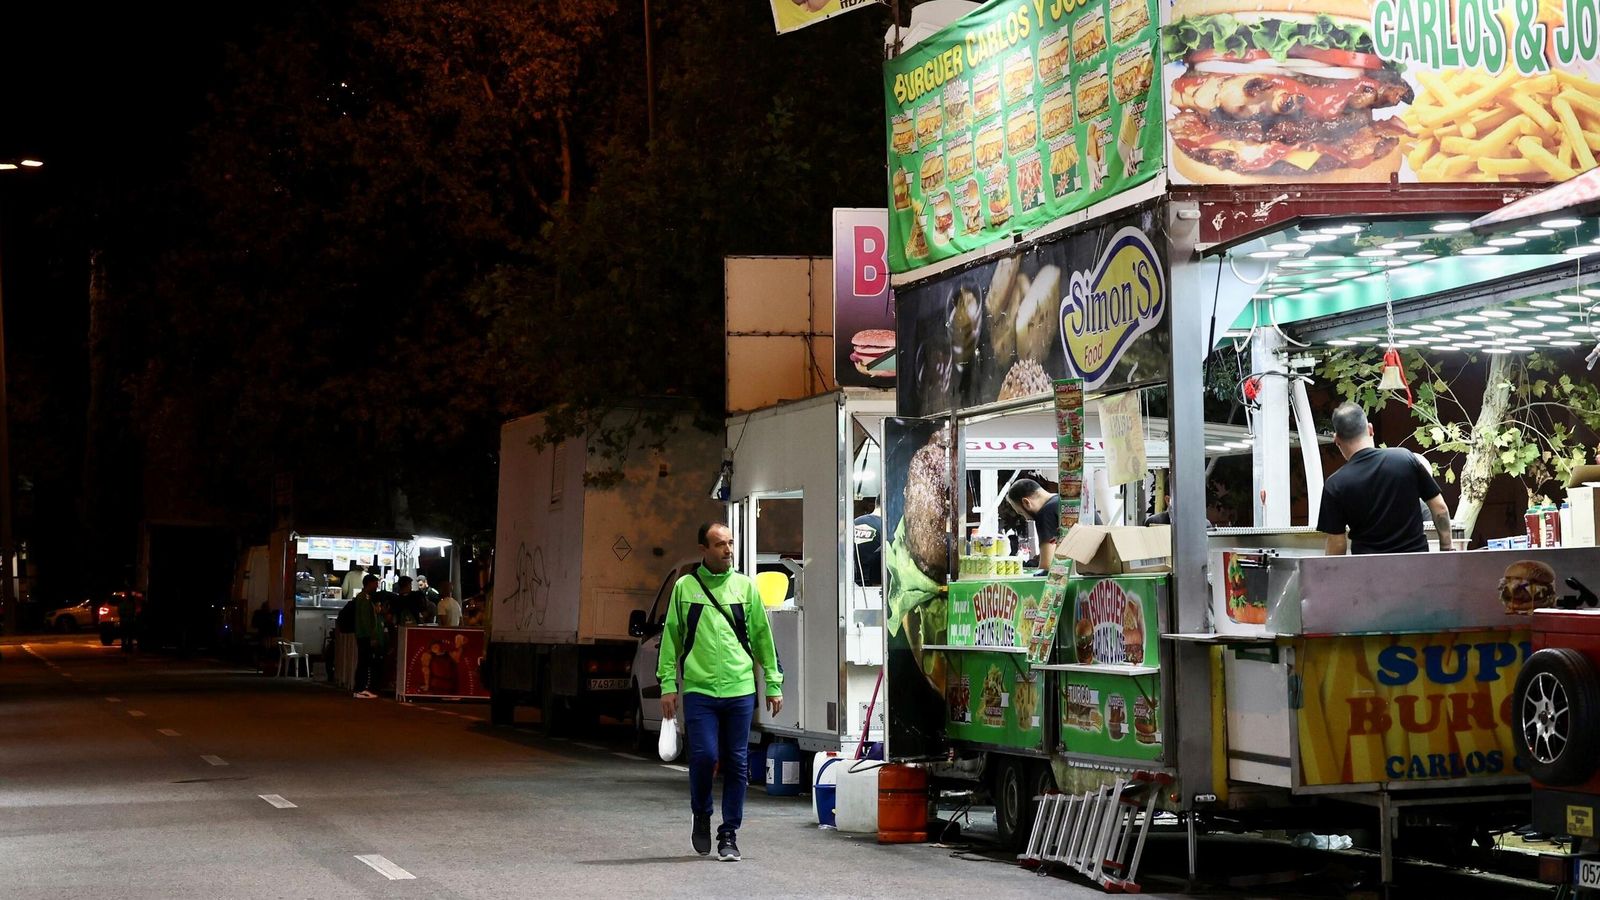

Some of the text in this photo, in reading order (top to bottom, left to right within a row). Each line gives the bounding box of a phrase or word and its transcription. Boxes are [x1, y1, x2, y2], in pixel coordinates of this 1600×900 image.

[893, 0, 1045, 105] BURGUER CARLOS Y
[1374, 0, 1503, 74] CARLOS
[1515, 0, 1547, 74] &
[1084, 338, 1104, 369] Food
[973, 582, 1019, 622] BURGUER
[1088, 579, 1127, 627] BURGUER
[1377, 642, 1532, 686] SUP
[1386, 750, 1504, 779] CARLOS
